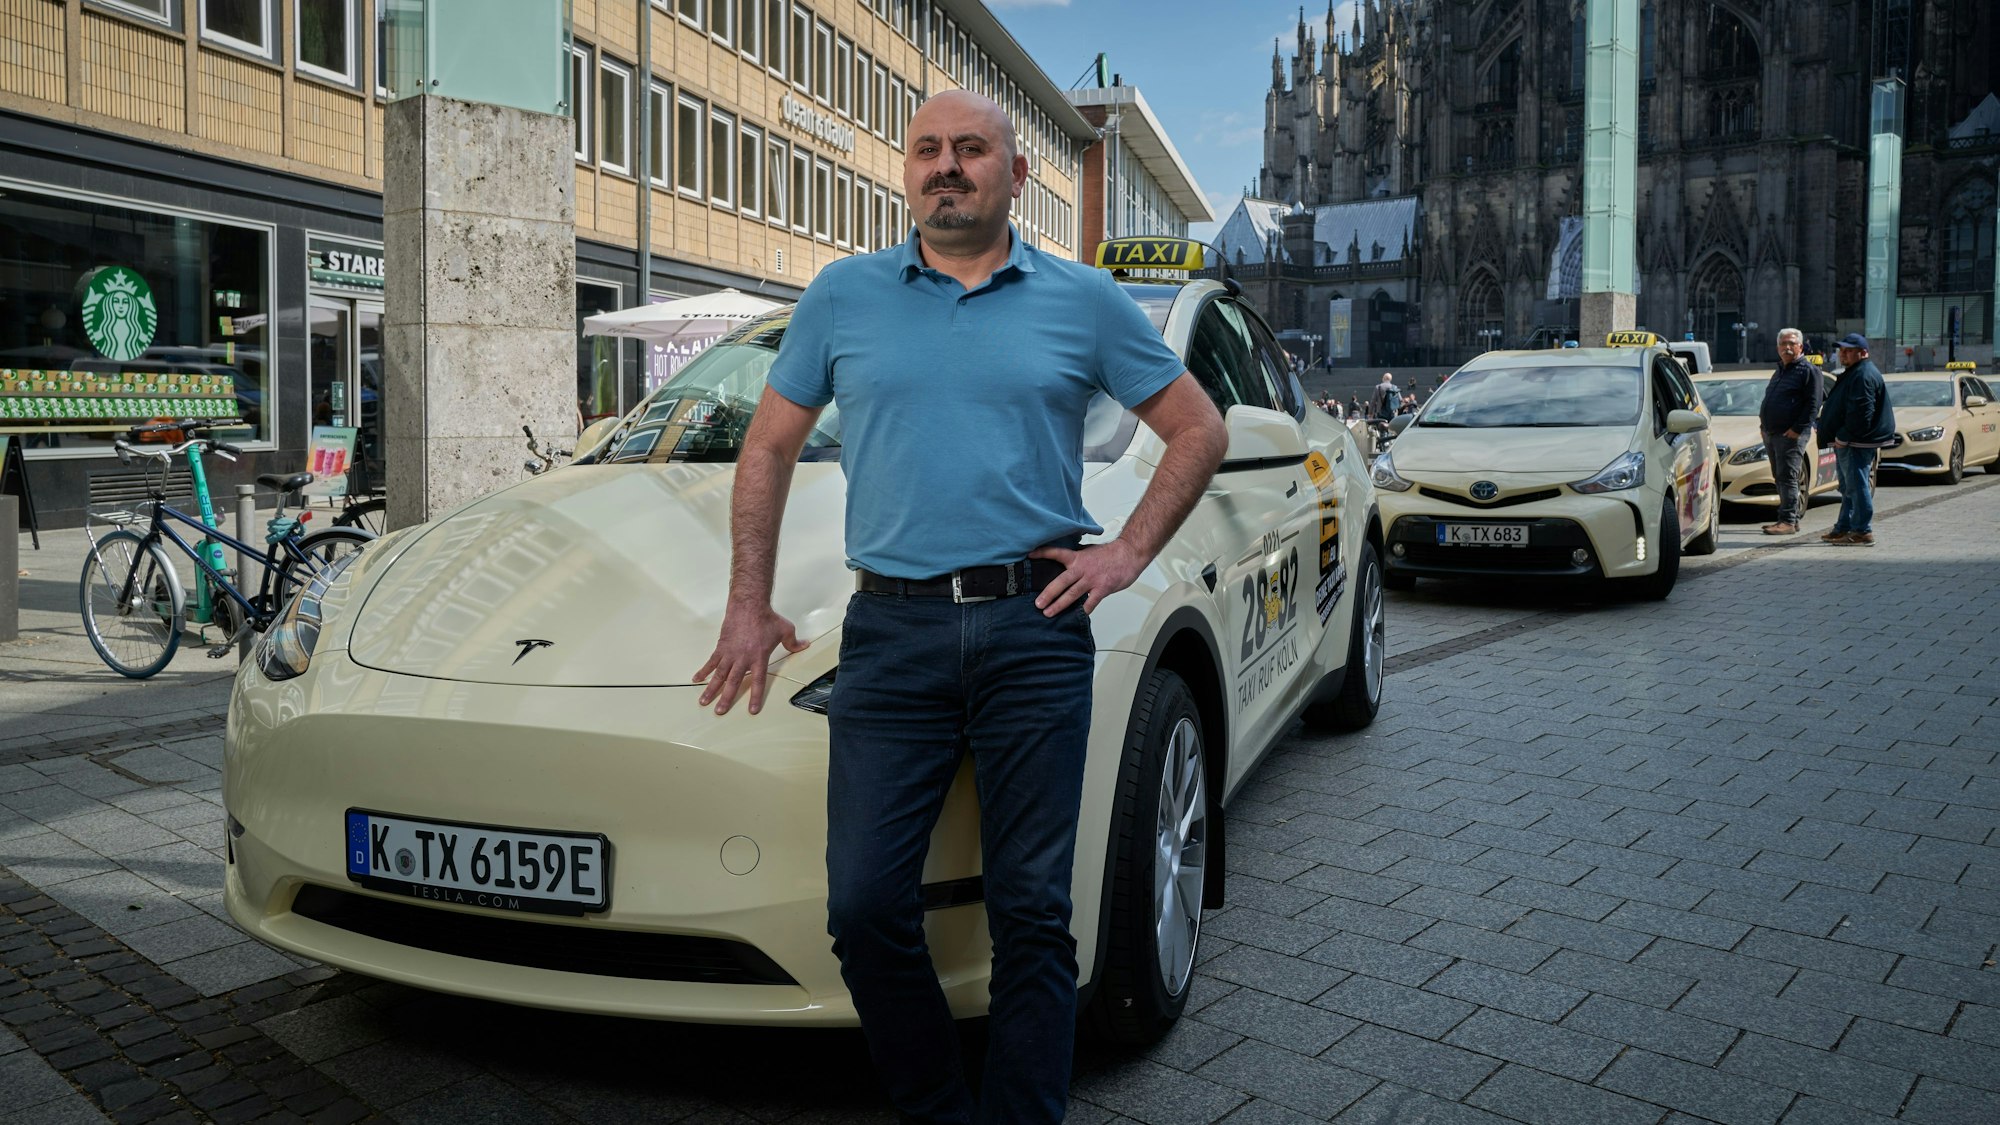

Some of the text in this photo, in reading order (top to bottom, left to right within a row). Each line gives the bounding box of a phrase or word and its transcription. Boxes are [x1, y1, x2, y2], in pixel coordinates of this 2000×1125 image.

[782, 90, 854, 153] dean&david
[1112, 243, 1180, 263] TAXI
[1614, 333, 1646, 343] TAXI
[653, 353, 668, 377] HOT
[200, 494, 215, 528] TIER
[1263, 529, 1281, 556] 0221
[1451, 526, 1522, 542] K TX 683
[1238, 636, 1299, 715] TAXI RUF KÖLN
[355, 850, 364, 865] D
[371, 823, 596, 896] K TX 6159E
[411, 884, 520, 910] TESLA.COM
